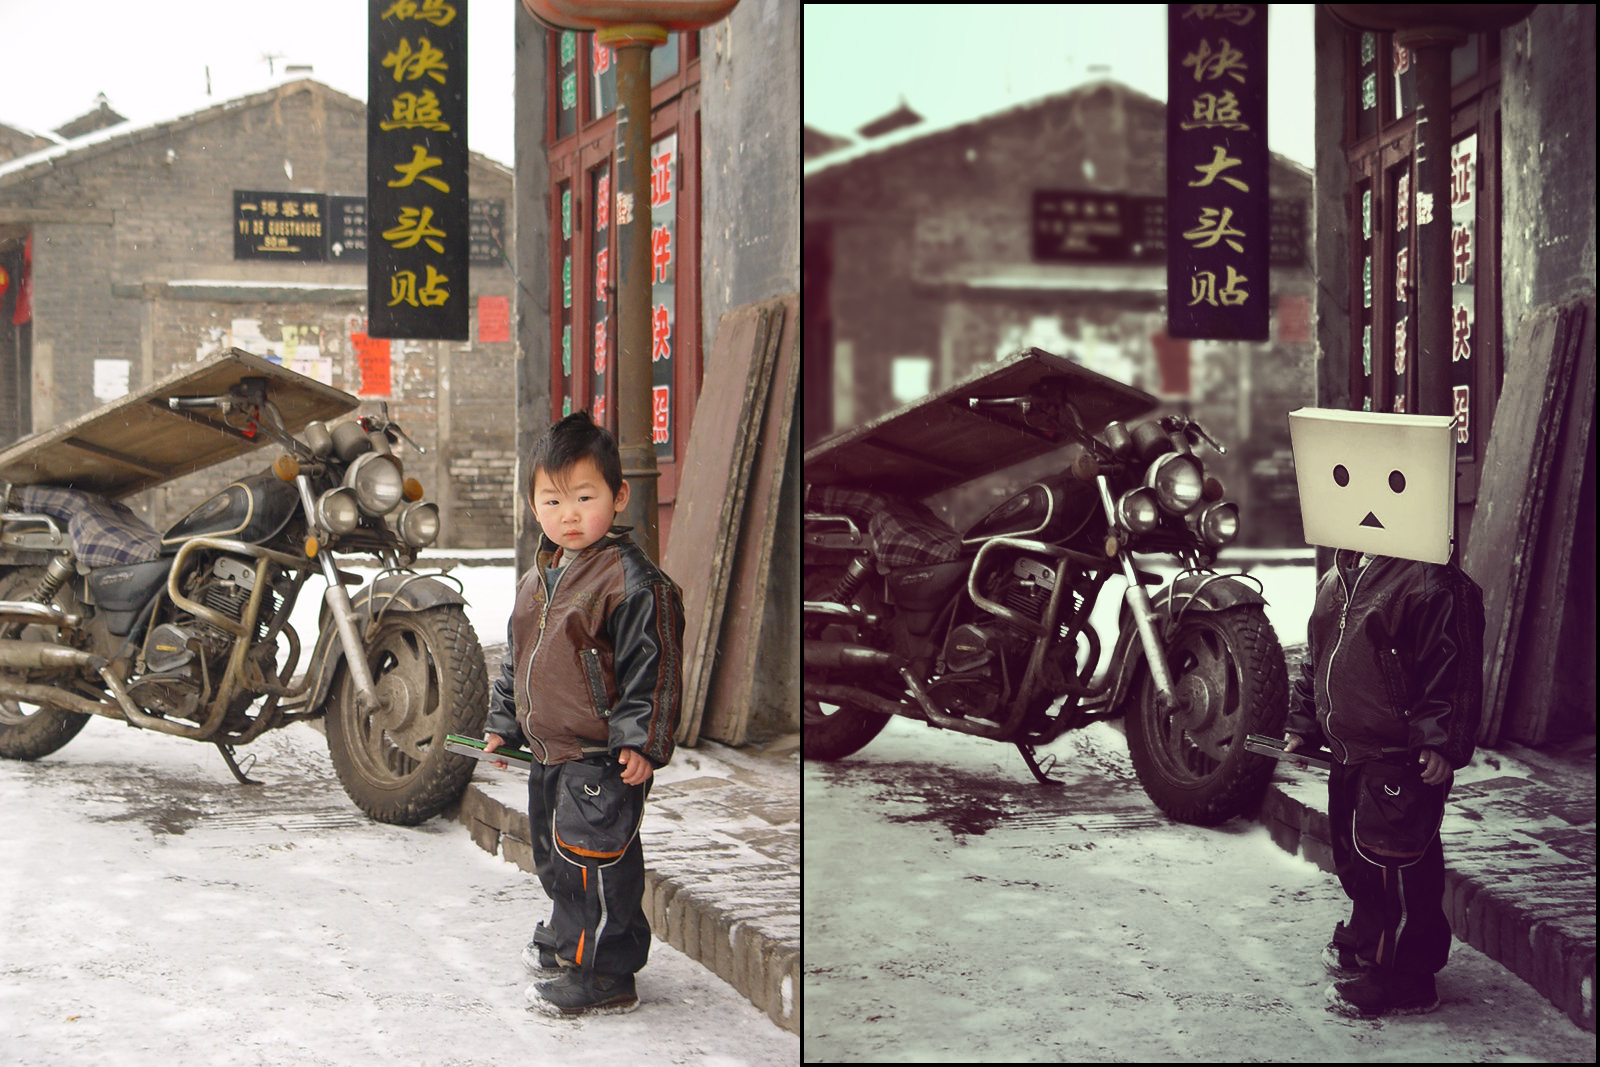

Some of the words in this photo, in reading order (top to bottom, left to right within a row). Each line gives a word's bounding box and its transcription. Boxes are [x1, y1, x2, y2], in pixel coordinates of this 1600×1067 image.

[269, 221, 321, 237] GUESTHOUSE
[651, 152, 674, 445] 证件快照
